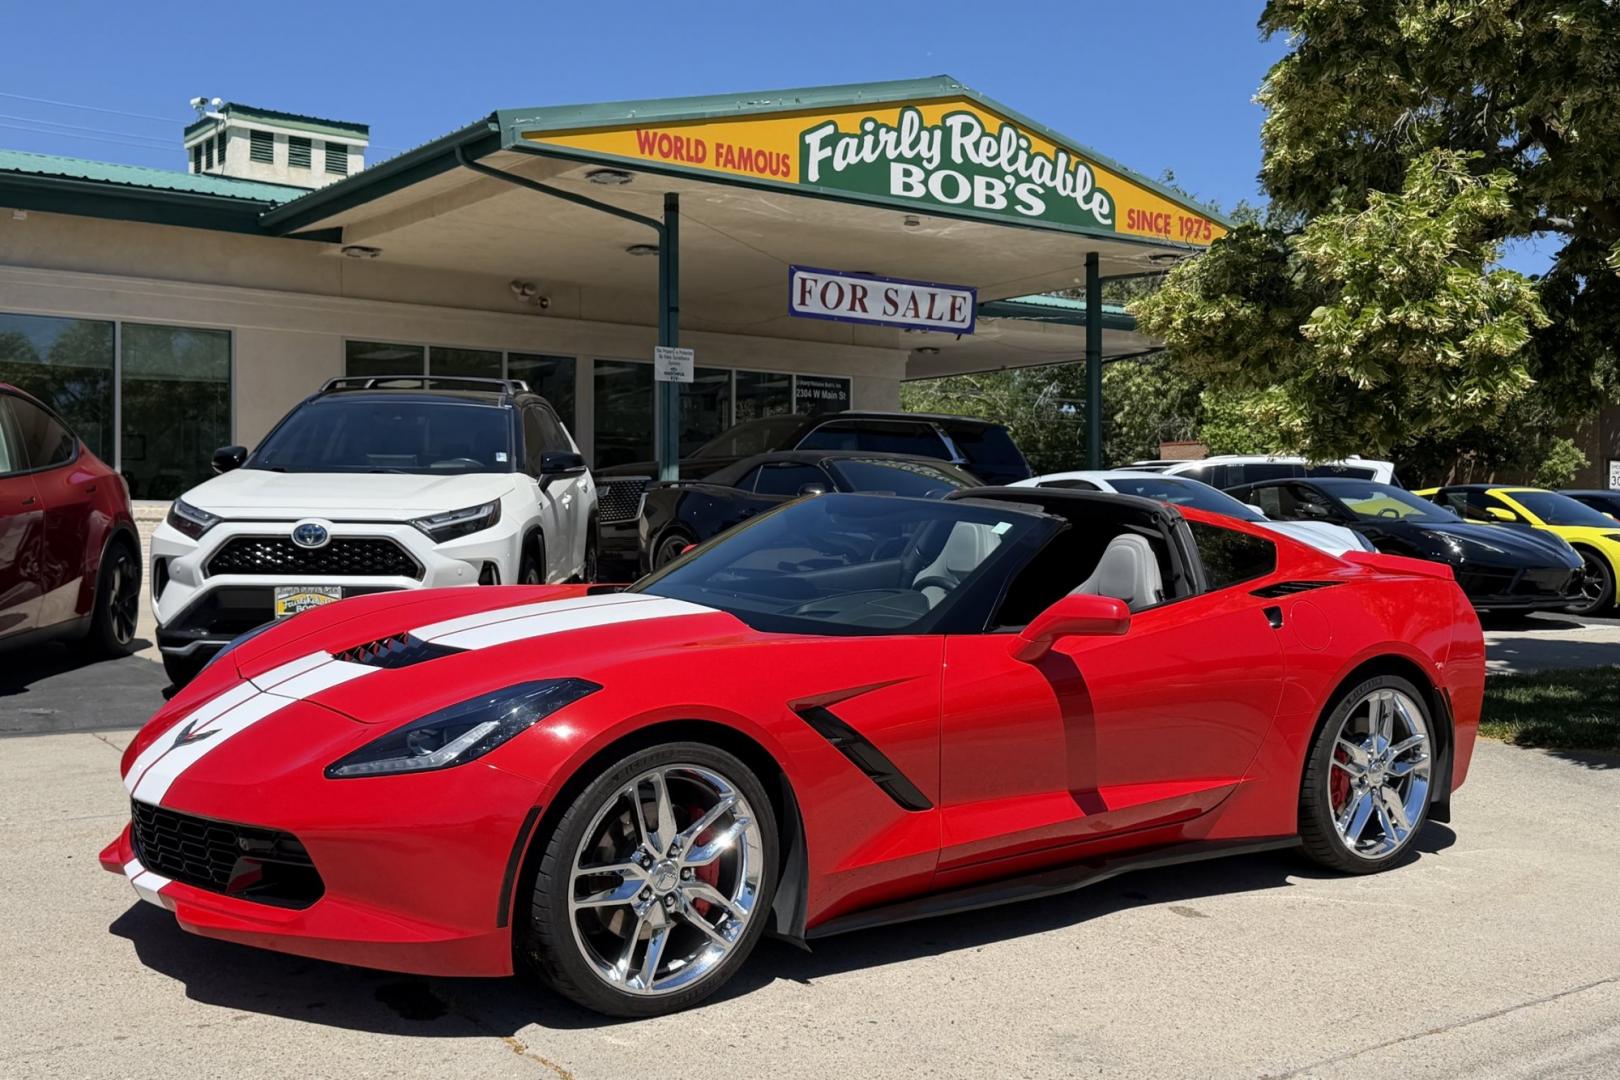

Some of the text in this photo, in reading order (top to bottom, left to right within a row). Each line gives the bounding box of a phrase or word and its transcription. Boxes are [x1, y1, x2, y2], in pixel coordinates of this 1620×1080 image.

[636, 128, 791, 178] WORLD FAMOUS
[804, 110, 1113, 226] Fairly Reliable
[890, 161, 1047, 217] BOB'S
[1127, 208, 1212, 241] SINCE 1975
[797, 276, 968, 324] FOR SALE
[796, 388, 846, 400] 2304 W Main St
